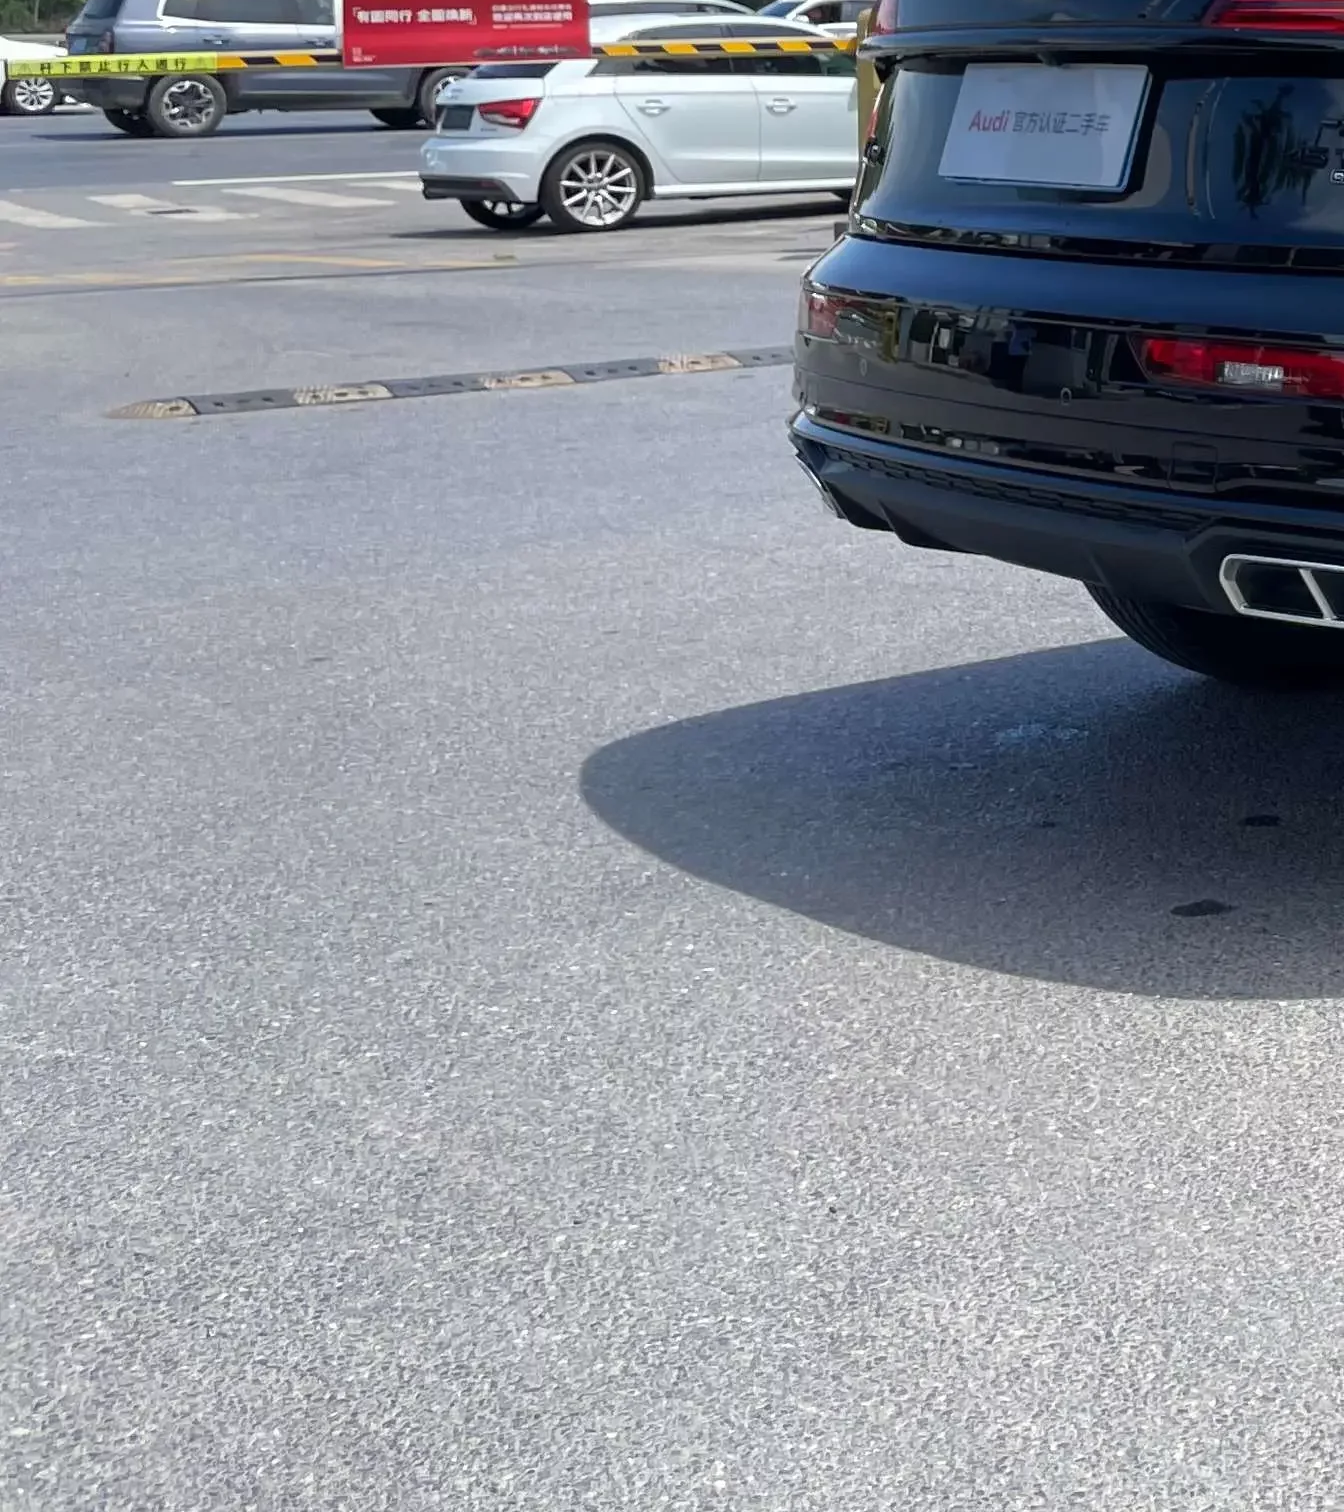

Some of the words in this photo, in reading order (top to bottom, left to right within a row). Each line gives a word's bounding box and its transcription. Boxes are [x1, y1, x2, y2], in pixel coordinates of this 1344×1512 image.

[968, 110, 1010, 132] Audi
[1012, 111, 1111, 136] 官方认证二手车
